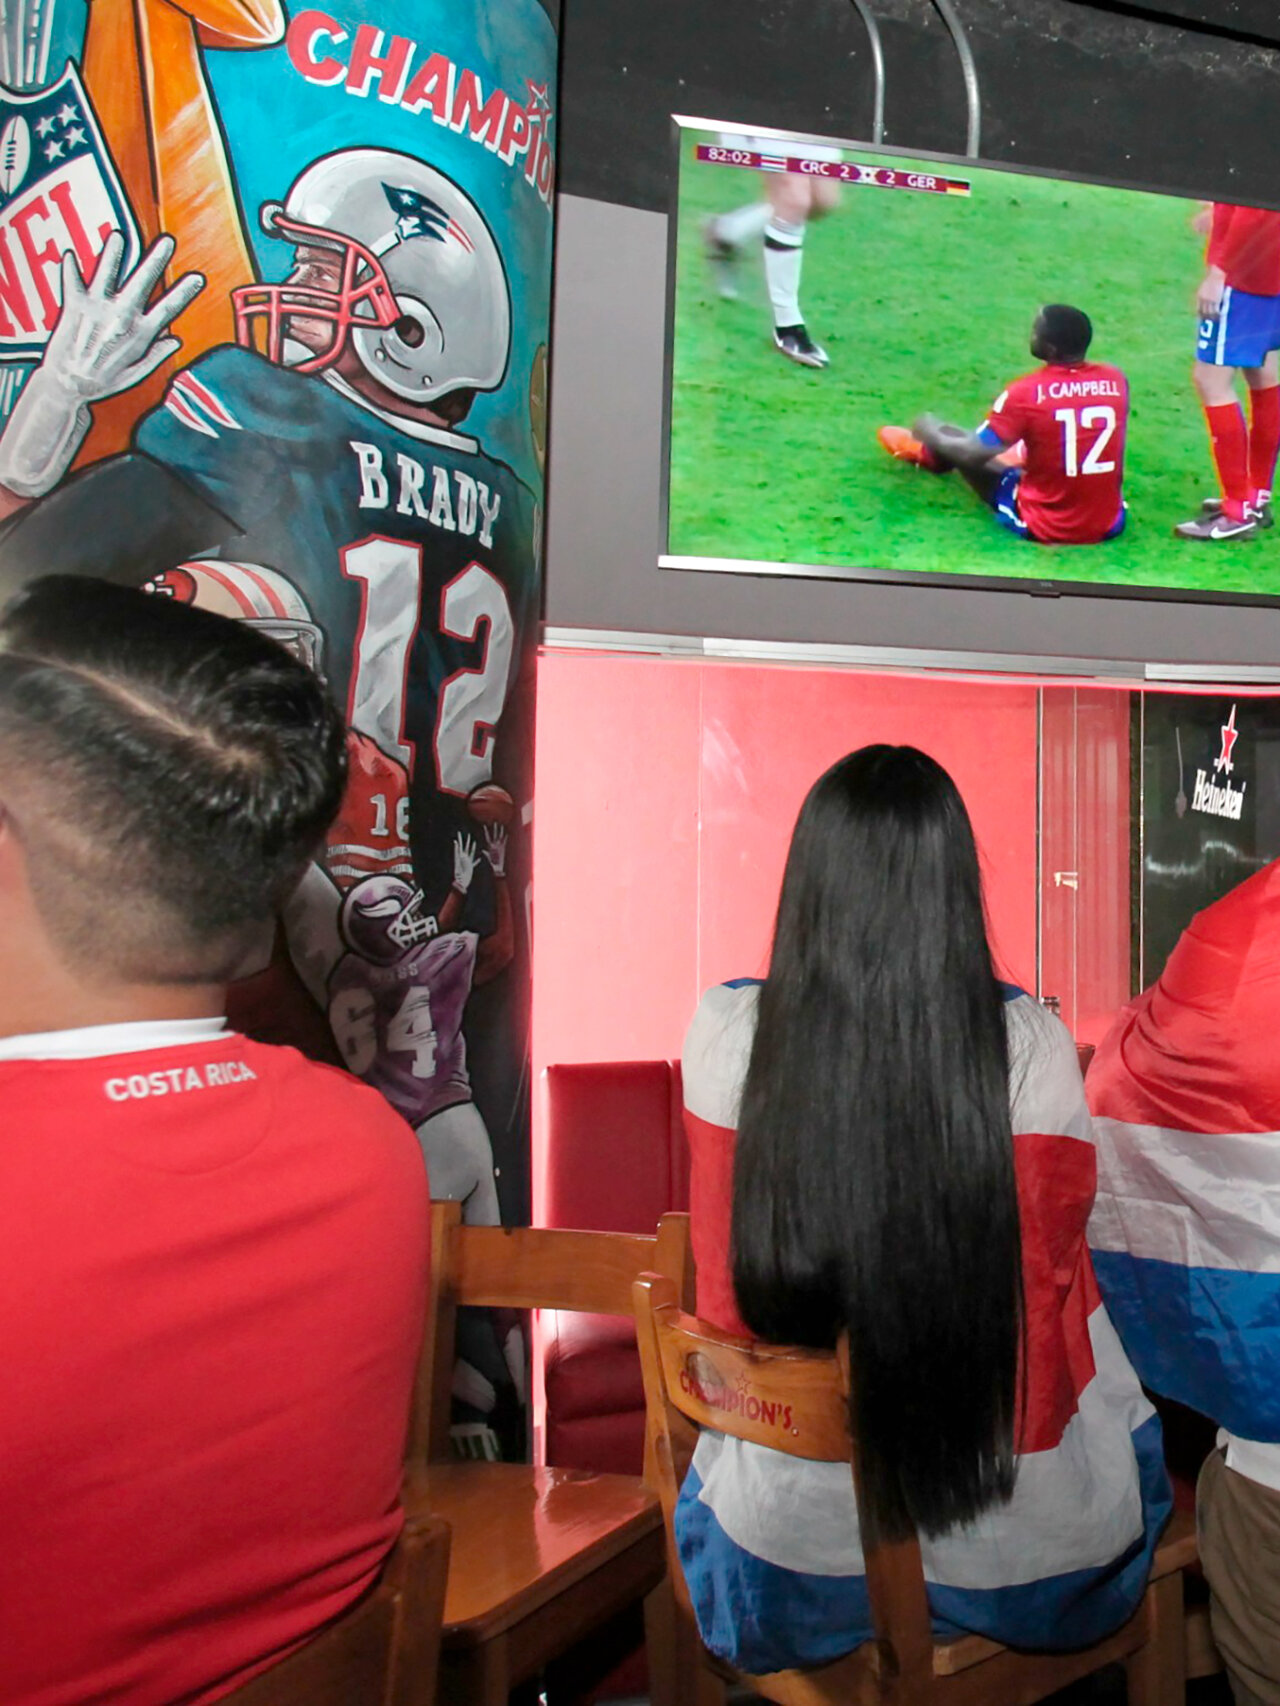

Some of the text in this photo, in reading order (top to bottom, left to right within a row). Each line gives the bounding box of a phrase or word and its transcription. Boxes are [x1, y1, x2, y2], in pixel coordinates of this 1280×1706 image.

[286, 10, 555, 212] CHAMPIO
[707, 147, 937, 190] 82:02 CRC 2 2 GER
[1036, 380, 1121, 405] J. CAMPBELL
[1054, 406, 1117, 478] 12
[350, 440, 502, 550] BRADY
[339, 533, 516, 798] 12
[1191, 768, 1245, 821] Heineken
[105, 1061, 257, 1102] COSTA RICA
